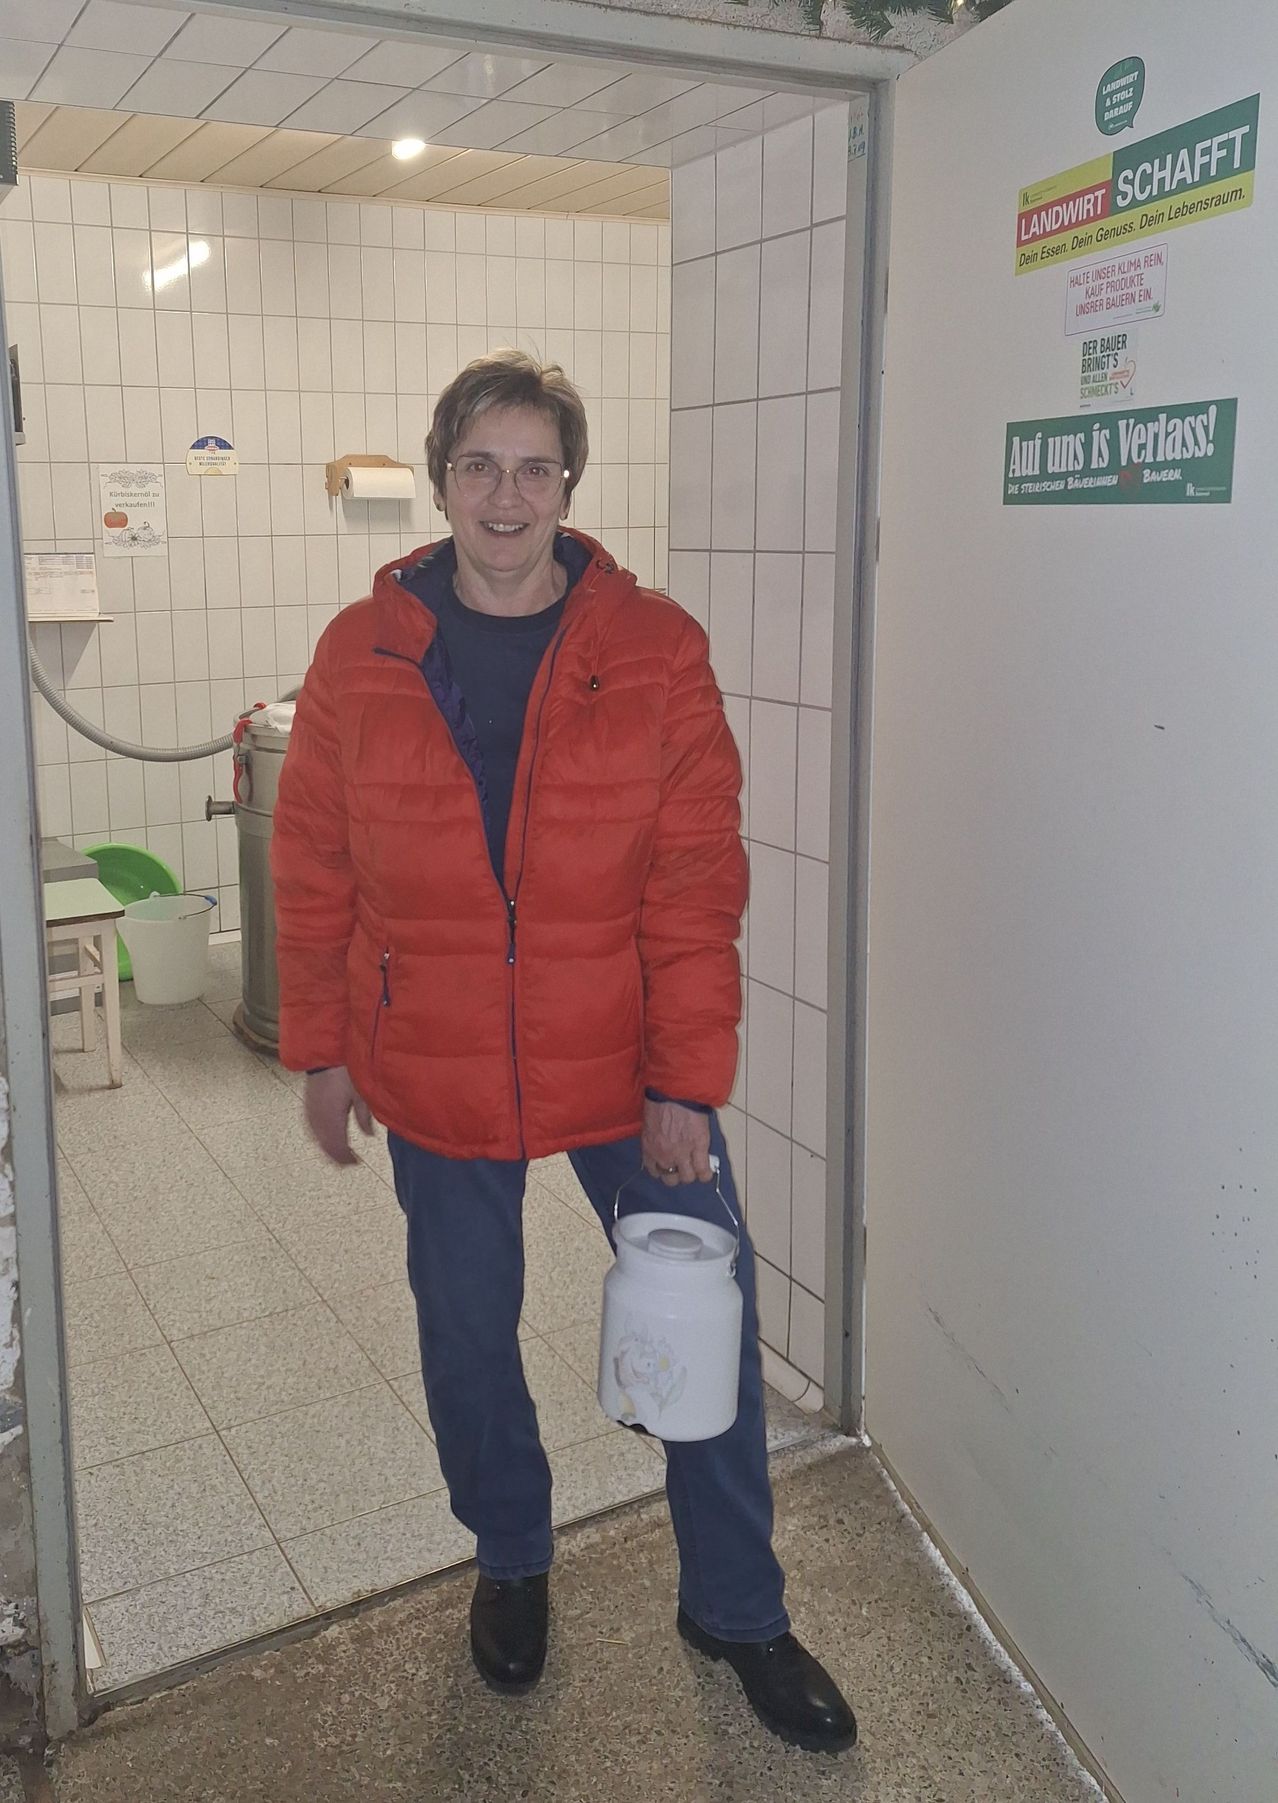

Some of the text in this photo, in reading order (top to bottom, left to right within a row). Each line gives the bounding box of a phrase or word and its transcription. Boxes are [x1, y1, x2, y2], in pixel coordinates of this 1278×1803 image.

[1102, 71, 1139, 95] LANDWIRT
[1112, 88, 1134, 104] STOLZ
[1104, 101, 1133, 121] DARAUF
[1020, 124, 1250, 241] LANDWIRT SCHAFFT
[1019, 187, 1246, 267] Dein Essen. Dein Genuss. Dein Lebensraum.
[1069, 271, 1090, 288] HALTE
[1092, 264, 1116, 282] UNSER
[1117, 258, 1142, 275] KLIMA
[1085, 273, 1145, 300] KAUF PRODUKTE
[1075, 298, 1104, 316] UNSRER
[1105, 292, 1136, 310] BAUERN
[1082, 334, 1128, 357] DER BAUER
[1081, 352, 1119, 374] BRINGT'S
[1008, 404, 1218, 478] Auf uns is Verlass!
[1008, 482, 1019, 495] DIE
